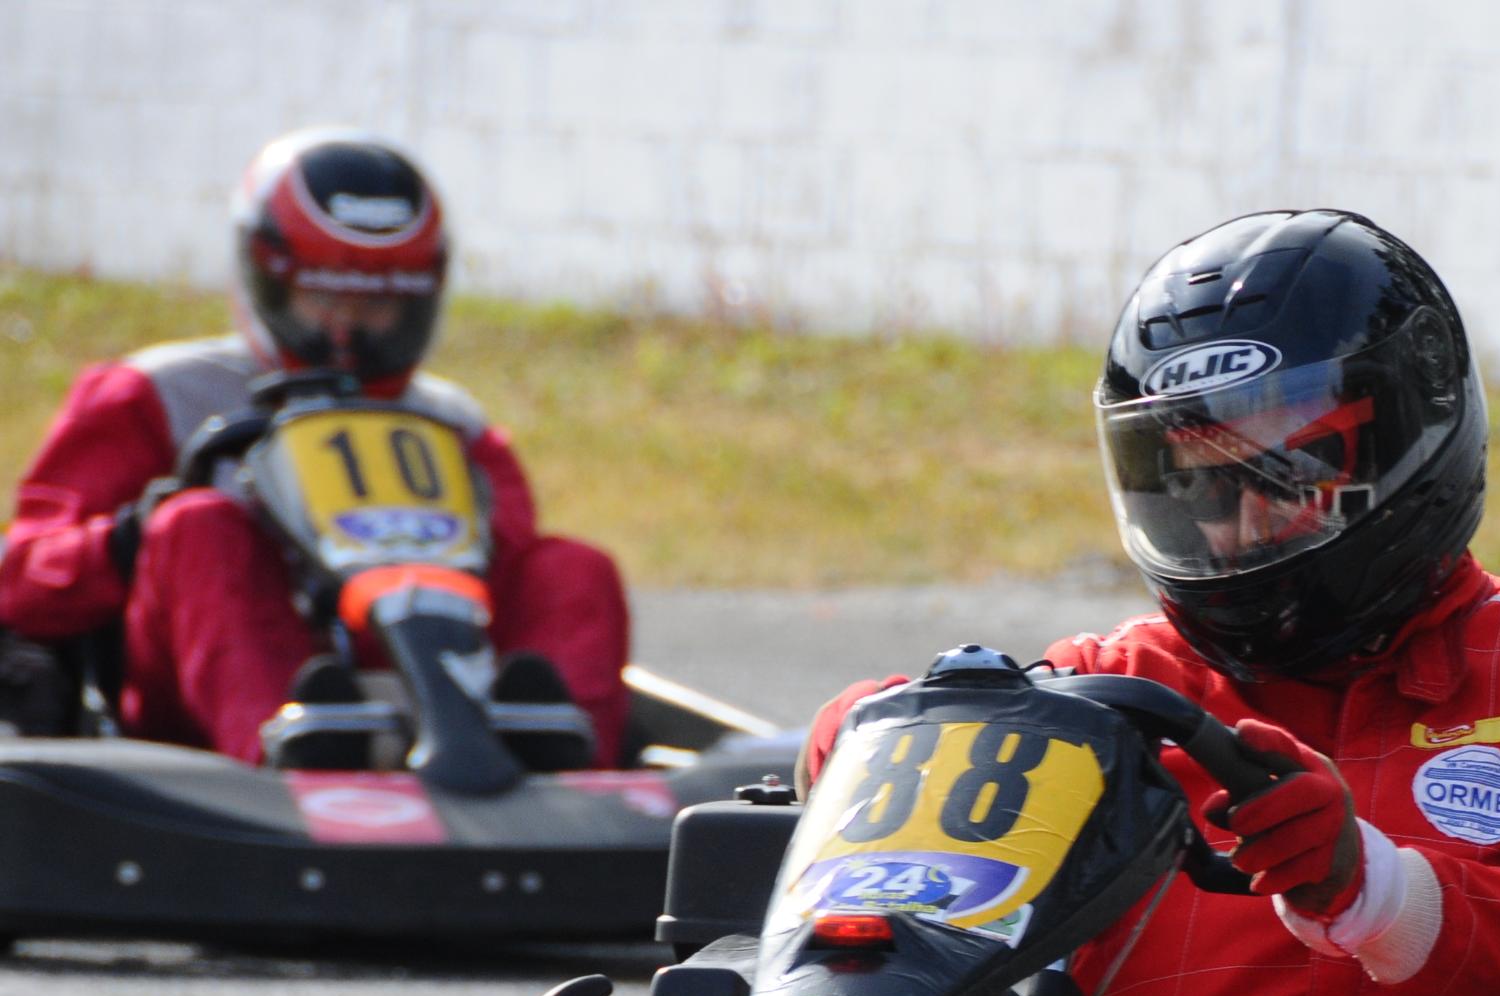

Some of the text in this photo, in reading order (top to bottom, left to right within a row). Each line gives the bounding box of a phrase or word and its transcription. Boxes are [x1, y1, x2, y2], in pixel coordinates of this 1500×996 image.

[1161, 348, 1253, 390] HJC
[323, 430, 443, 500] 10
[838, 722, 1051, 843] 88
[842, 865, 928, 898] 24
